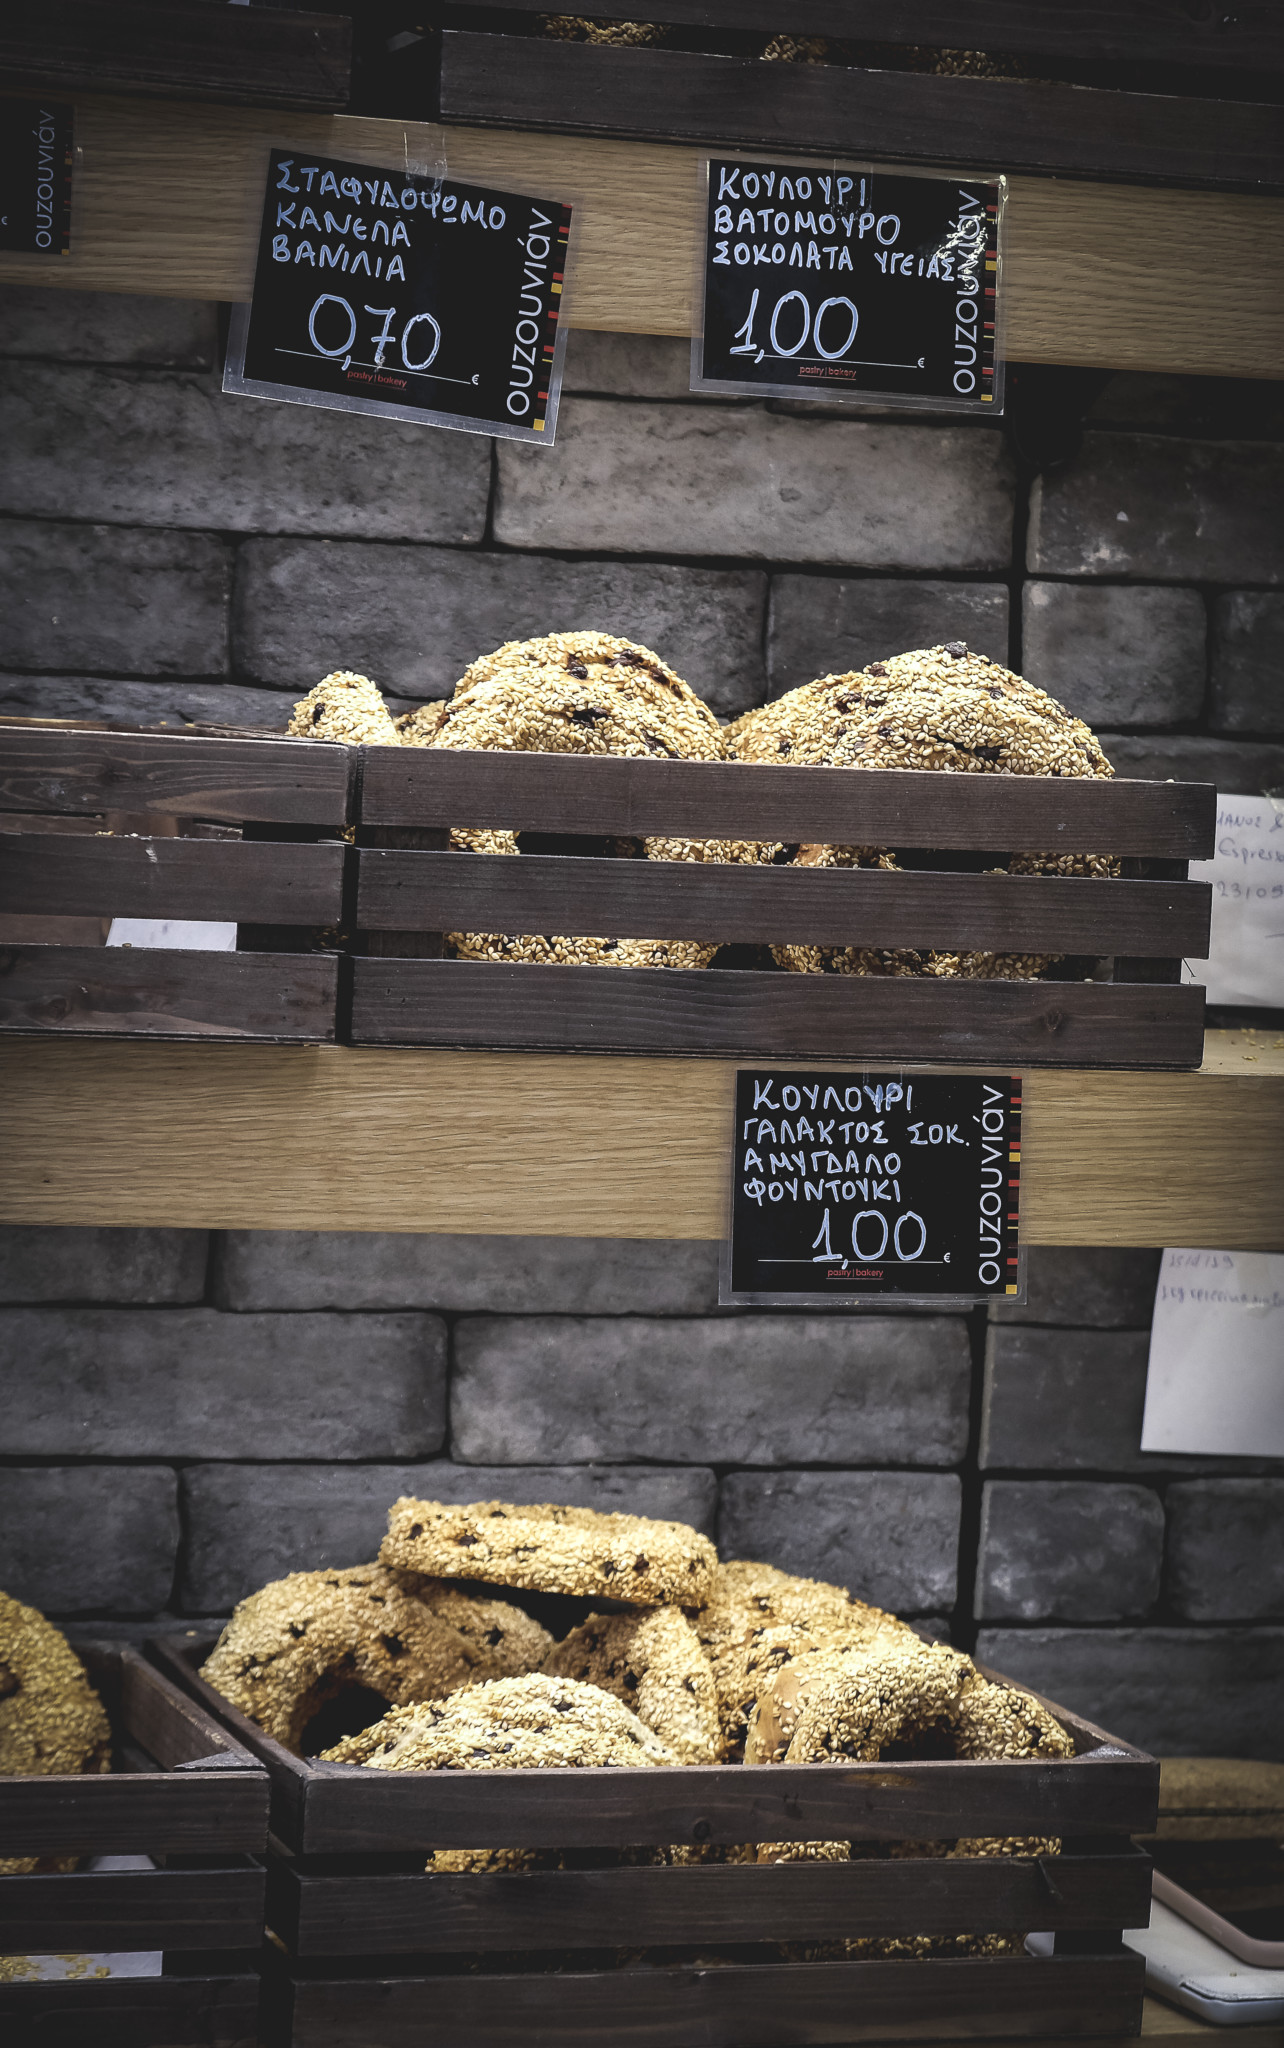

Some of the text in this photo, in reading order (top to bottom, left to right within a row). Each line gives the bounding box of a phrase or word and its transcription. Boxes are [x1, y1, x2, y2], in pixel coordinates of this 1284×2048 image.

[717, 167, 866, 206] ΚΟΥΛΟΥΡΙ
[276, 202, 411, 247] ΚΑΝΕΛΑ
[714, 205, 901, 245] ΒΑΤΟΜΟΥΡΟ
[272, 234, 406, 281] ΒΑΝΙΛΙΑ
[712, 241, 956, 281] ΣΟΚΟΛΑΤΑ ΥΓΕΙΑΣ
[308, 293, 441, 371] 0,70
[729, 288, 859, 364] 1,00
[753, 1079, 912, 1113] ΚΟΥΛΟΥΡΙ
[744, 1116, 970, 1146] ΓΑΛΑΚΤΟΣ ΣΟΚ.
[744, 1147, 901, 1176] ΑΜΥΓΔΑΛΟ
[743, 1177, 901, 1206] ΦΟΥΝΤΟΥΚΙ
[812, 1208, 927, 1270] 1,00
